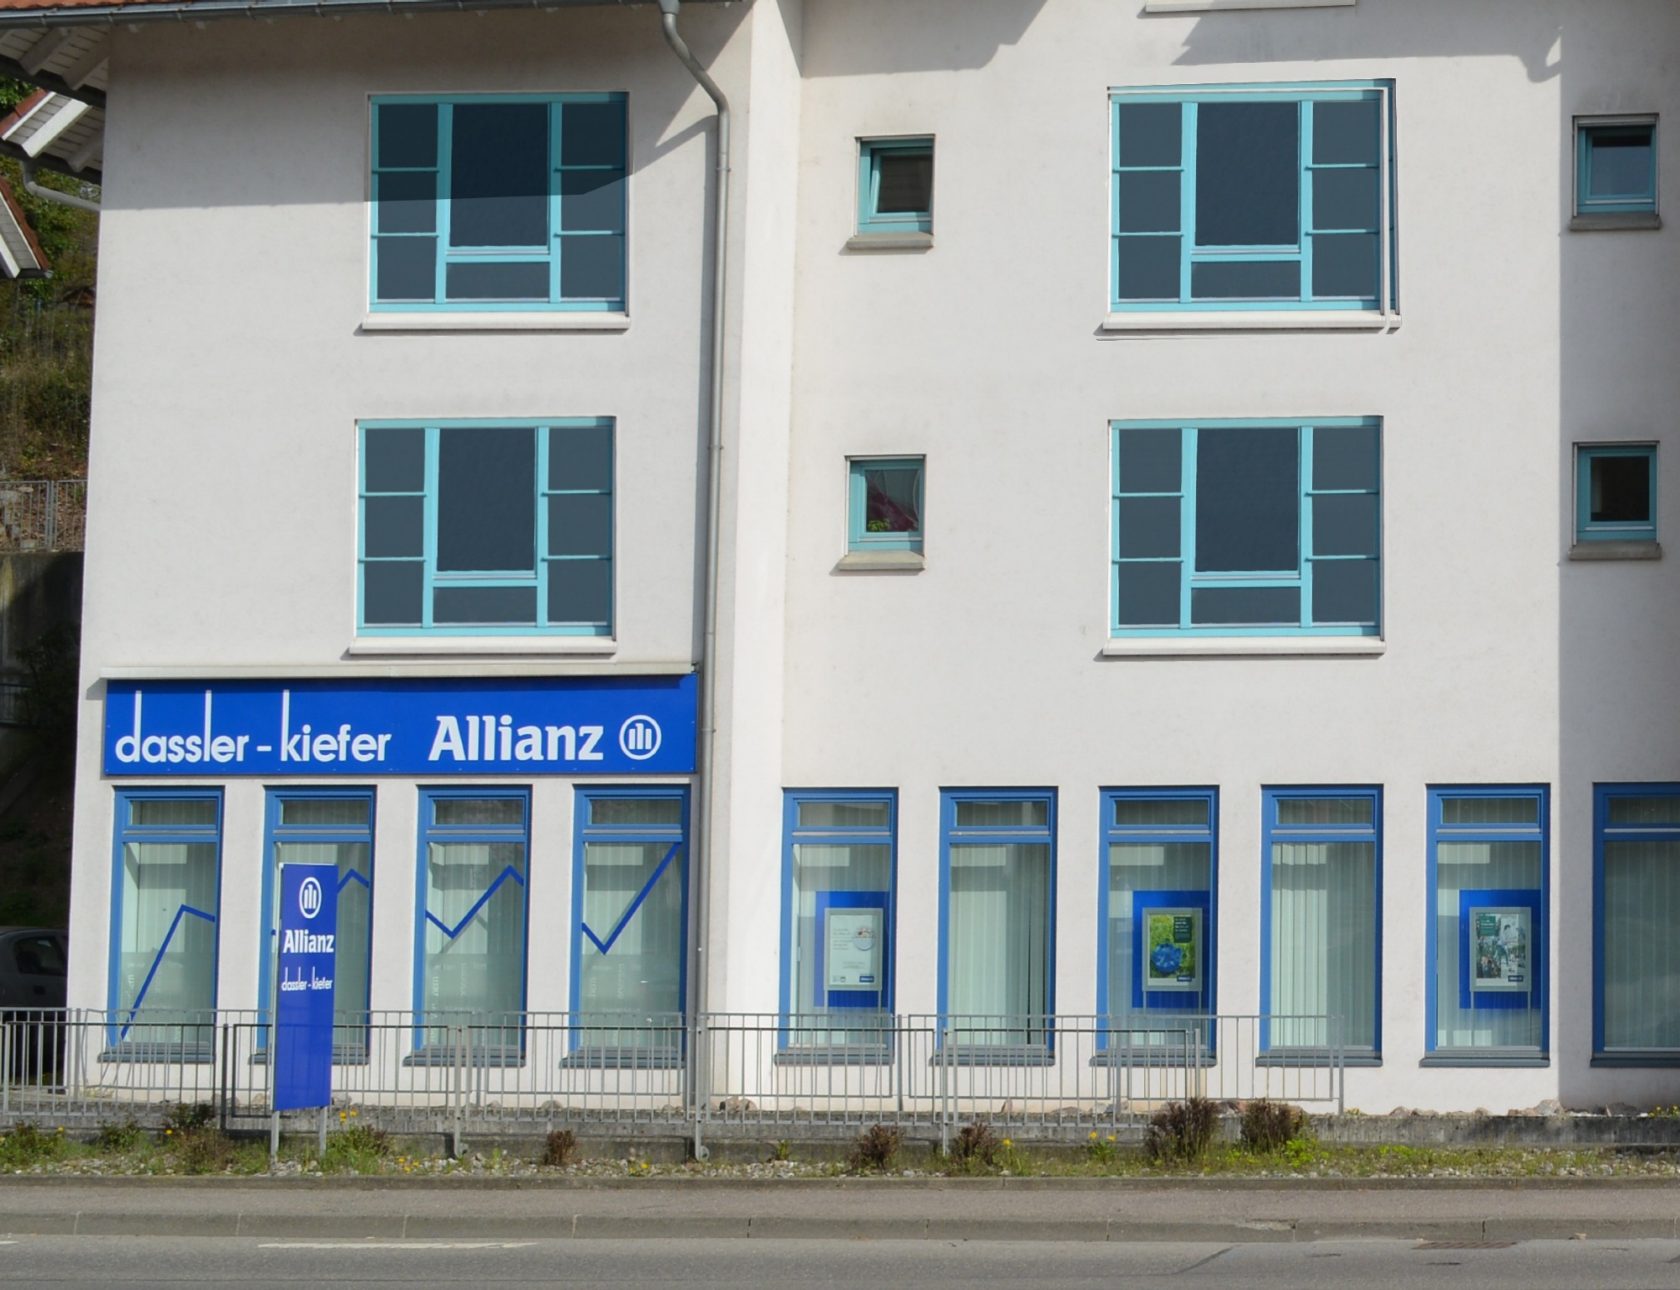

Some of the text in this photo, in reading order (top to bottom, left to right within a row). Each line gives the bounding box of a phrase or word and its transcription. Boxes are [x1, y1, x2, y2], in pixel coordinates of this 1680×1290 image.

[115, 689, 249, 763] dassler
[280, 689, 392, 762] kiefer
[428, 714, 604, 761] Allianz
[283, 929, 335, 954] Allianz
[281, 966, 307, 991] dassler
[311, 966, 333, 990] kiefer
